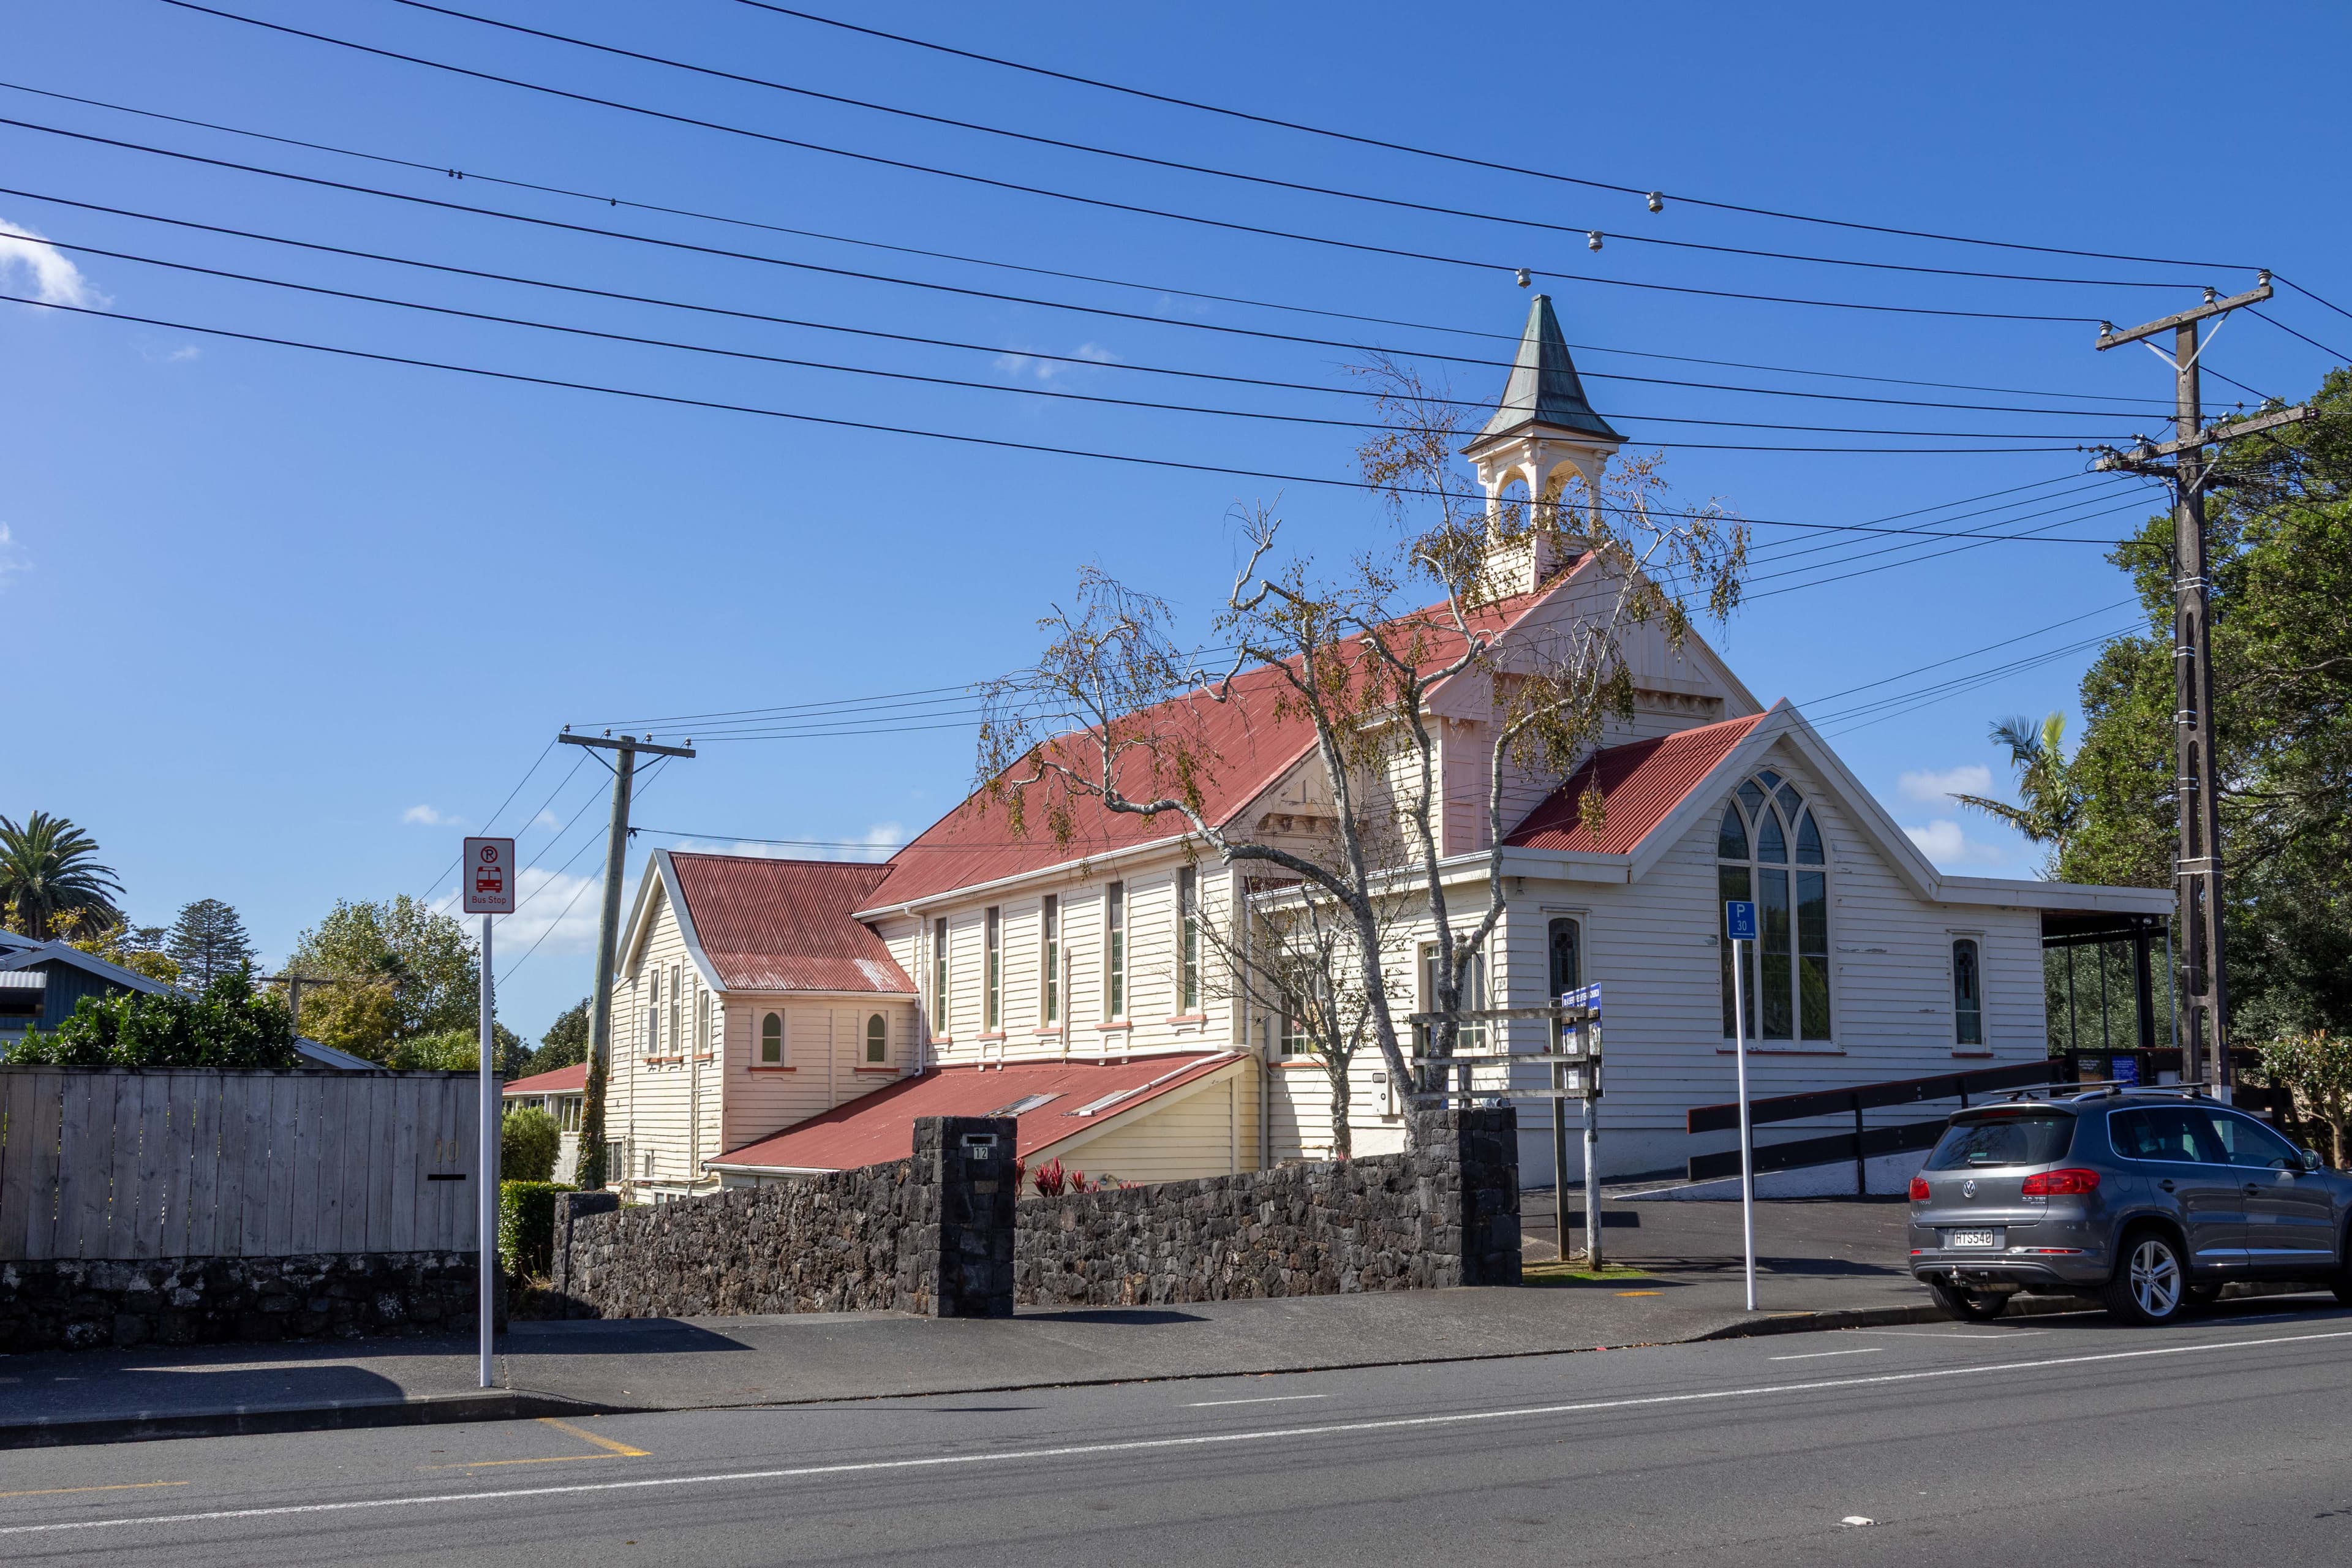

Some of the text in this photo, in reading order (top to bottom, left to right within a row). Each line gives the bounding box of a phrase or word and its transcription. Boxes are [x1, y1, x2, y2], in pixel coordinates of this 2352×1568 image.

[489, 895, 506, 905] Stop
[1736, 904, 1745, 918] P
[1737, 920, 1747, 931] 30
[976, 1148, 986, 1158] 12
[1956, 1231, 1991, 1243] HTS540
